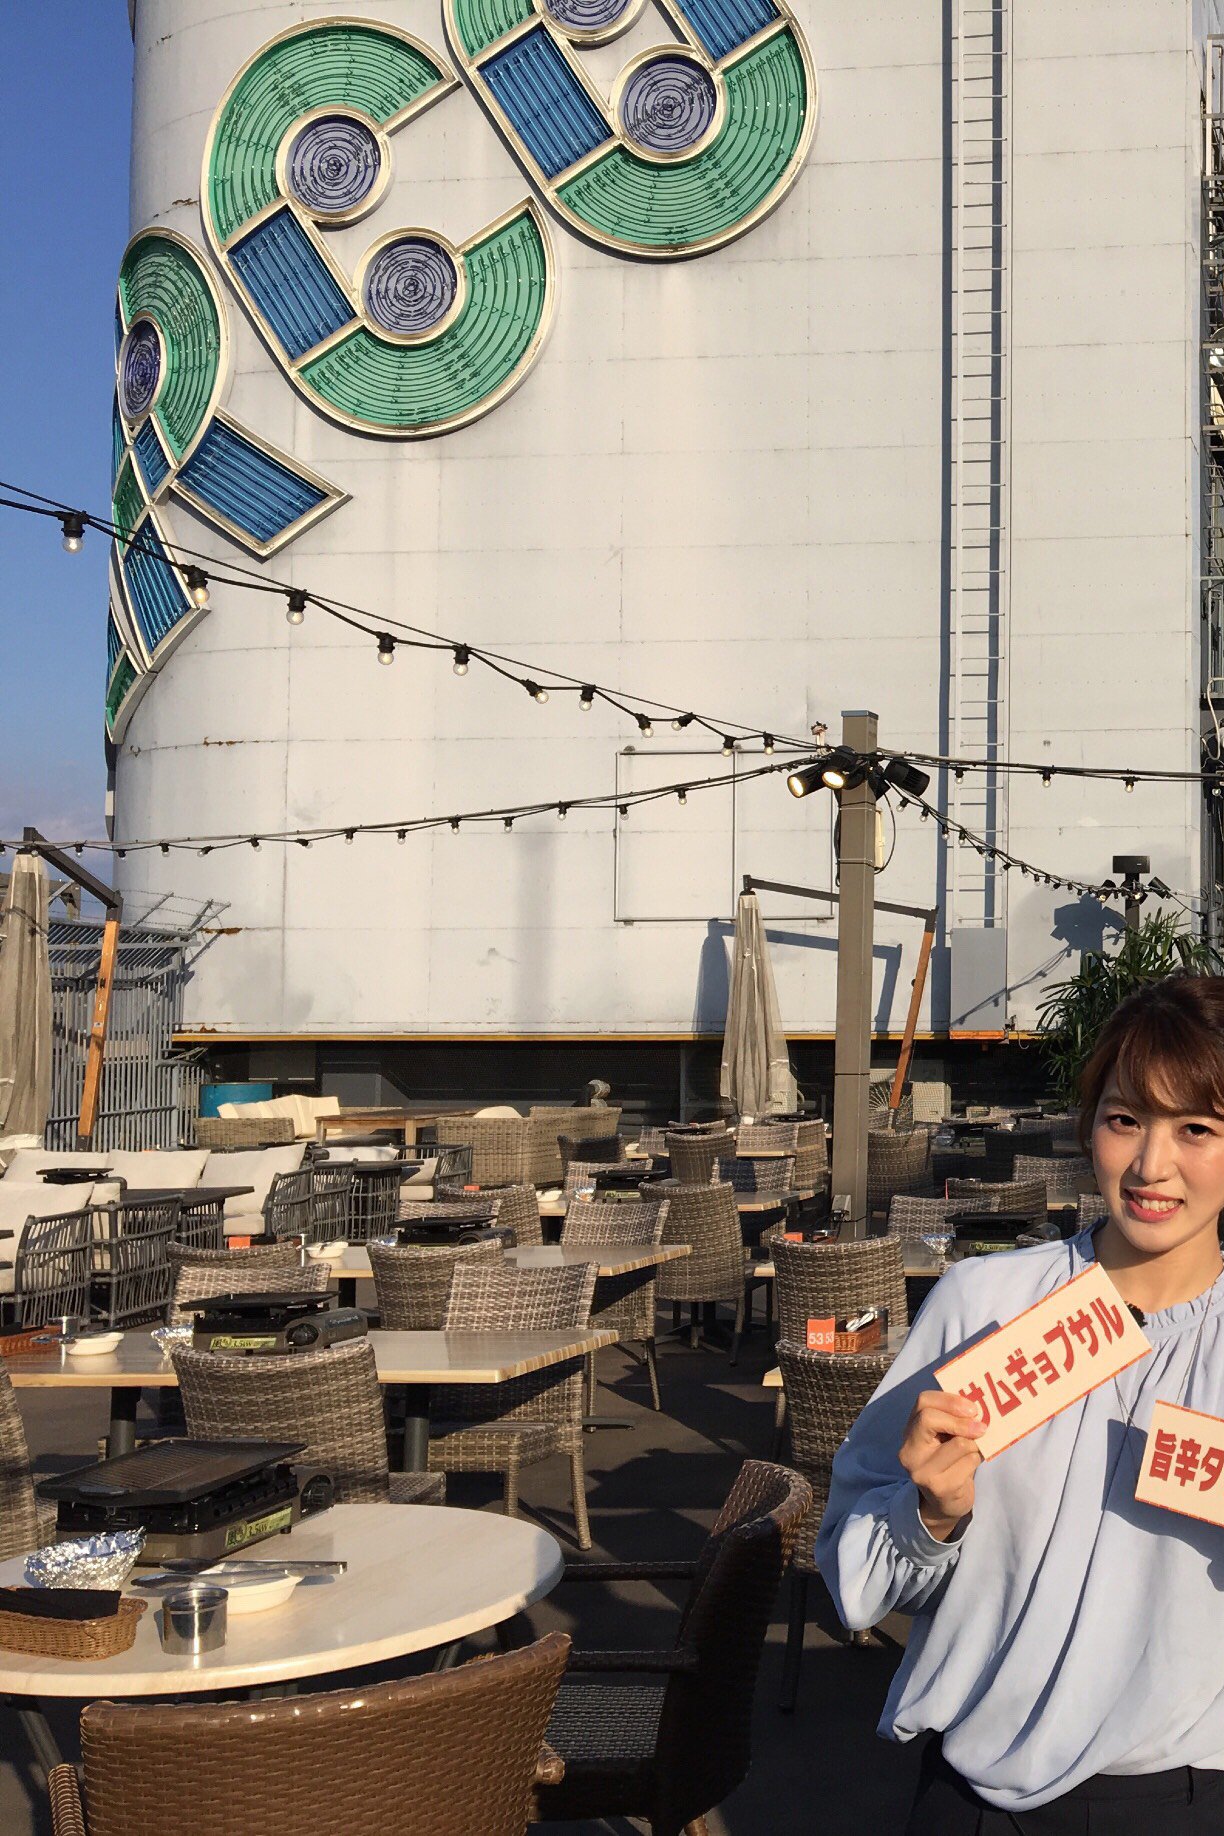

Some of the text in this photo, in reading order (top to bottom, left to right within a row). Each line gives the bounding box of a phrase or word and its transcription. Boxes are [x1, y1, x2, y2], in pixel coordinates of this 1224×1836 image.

[808, 1332, 824, 1345] 53
[958, 1295, 1126, 1430] サムギョプサル
